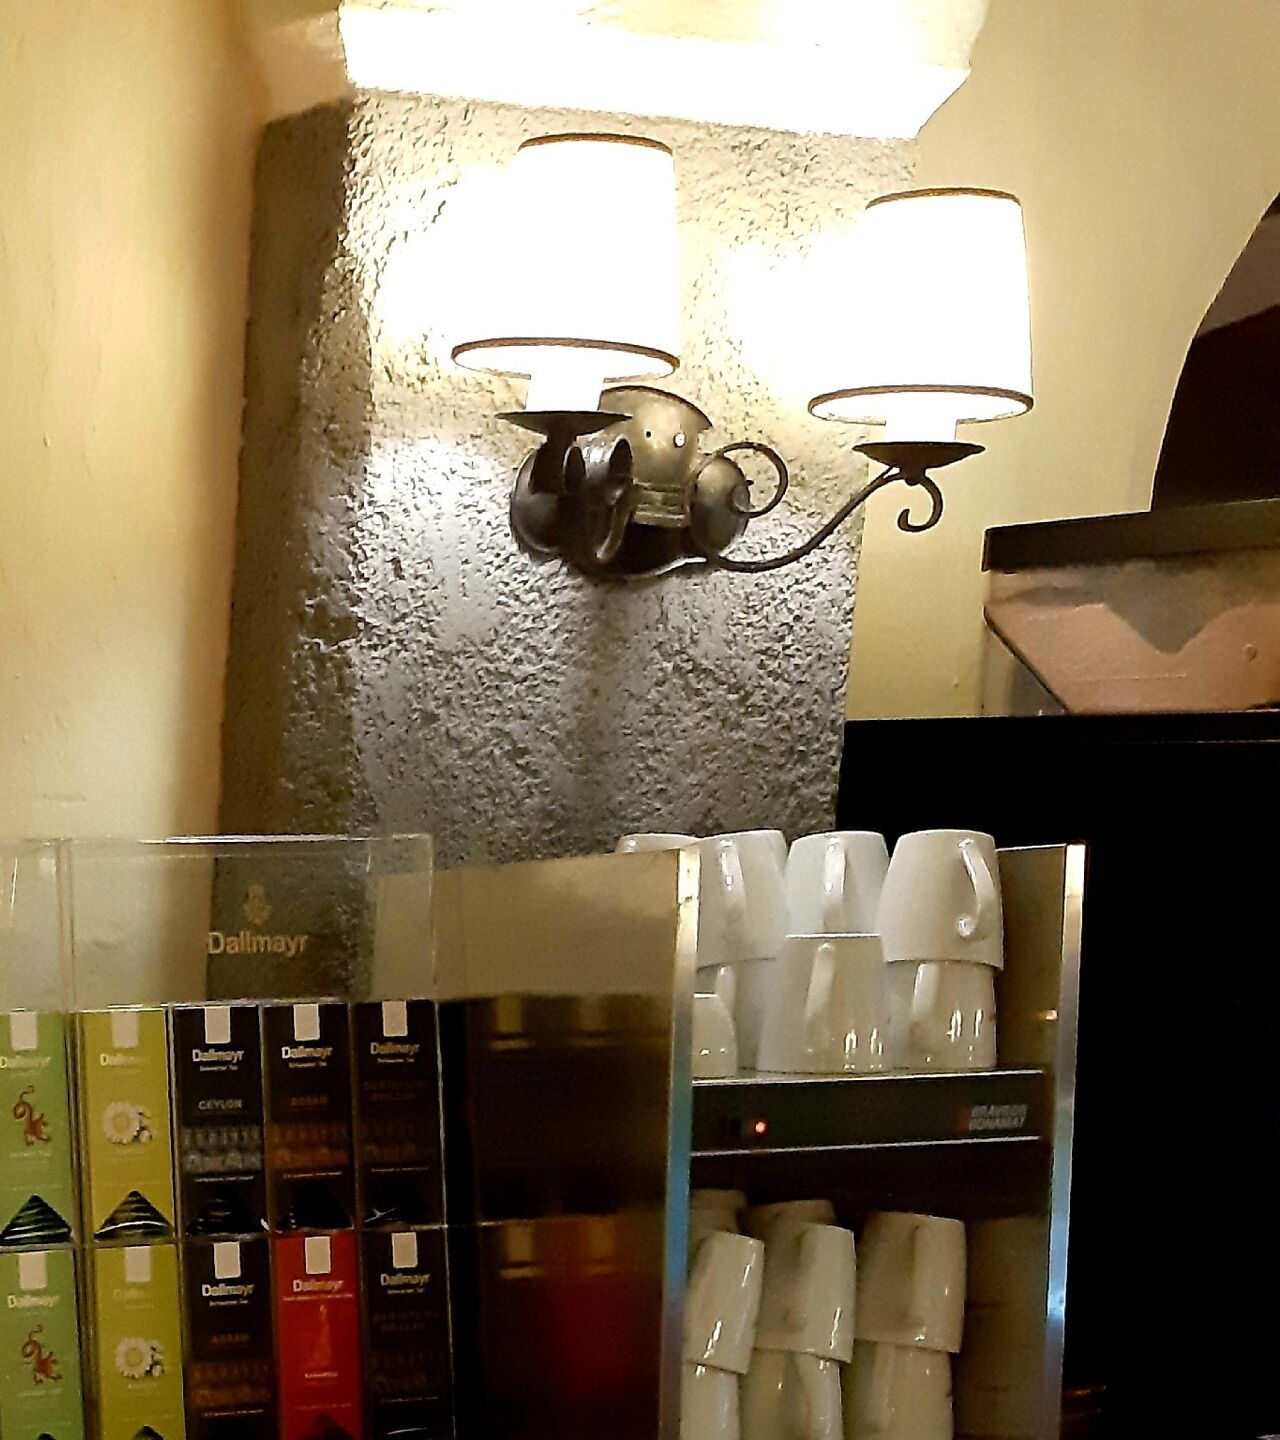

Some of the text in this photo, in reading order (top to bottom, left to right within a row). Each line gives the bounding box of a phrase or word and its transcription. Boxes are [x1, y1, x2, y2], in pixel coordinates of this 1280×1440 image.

[207, 931, 309, 958] Dallmayr
[192, 1048, 245, 1063] Dallmayr
[281, 1045, 334, 1060] Dallmayr
[370, 1041, 421, 1056] Dallmayr
[198, 1098, 243, 1110] CEYLON
[293, 1278, 344, 1293] Dallmayr
[380, 1272, 431, 1287] Dallmayr
[201, 1283, 255, 1298] Dallmayr
